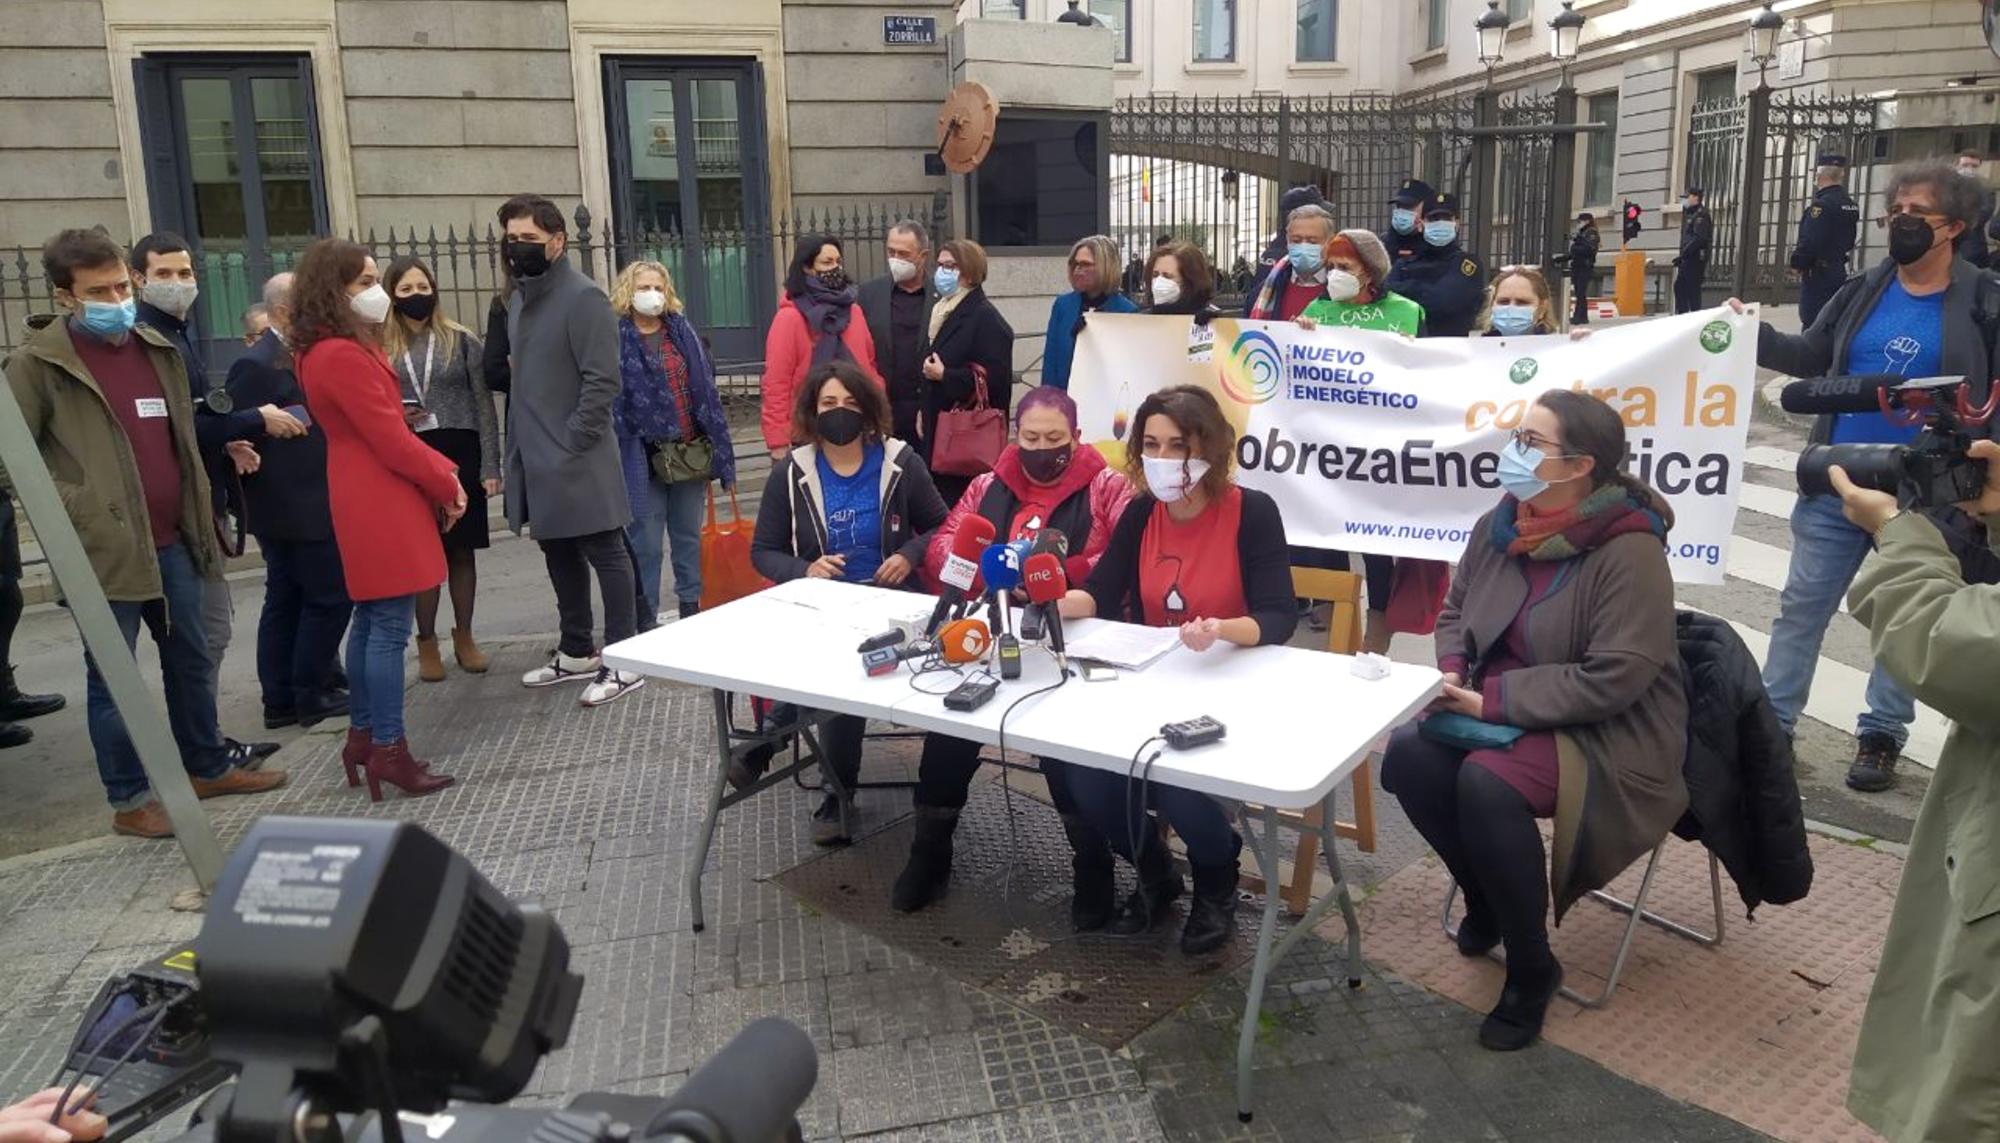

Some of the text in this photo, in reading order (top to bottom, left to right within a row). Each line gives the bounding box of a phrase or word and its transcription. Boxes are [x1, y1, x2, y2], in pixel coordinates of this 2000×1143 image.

[896, 18, 923, 26] CALLE
[888, 31, 932, 42] ZORRILLA
[1340, 306, 1384, 324] CASA
[1293, 344, 1365, 366] NUEVO
[1293, 365, 1374, 386] MODELO
[1294, 385, 1418, 410] ENERGÉTICO
[1684, 371, 1737, 428] la
[1029, 568, 1051, 583] rne
